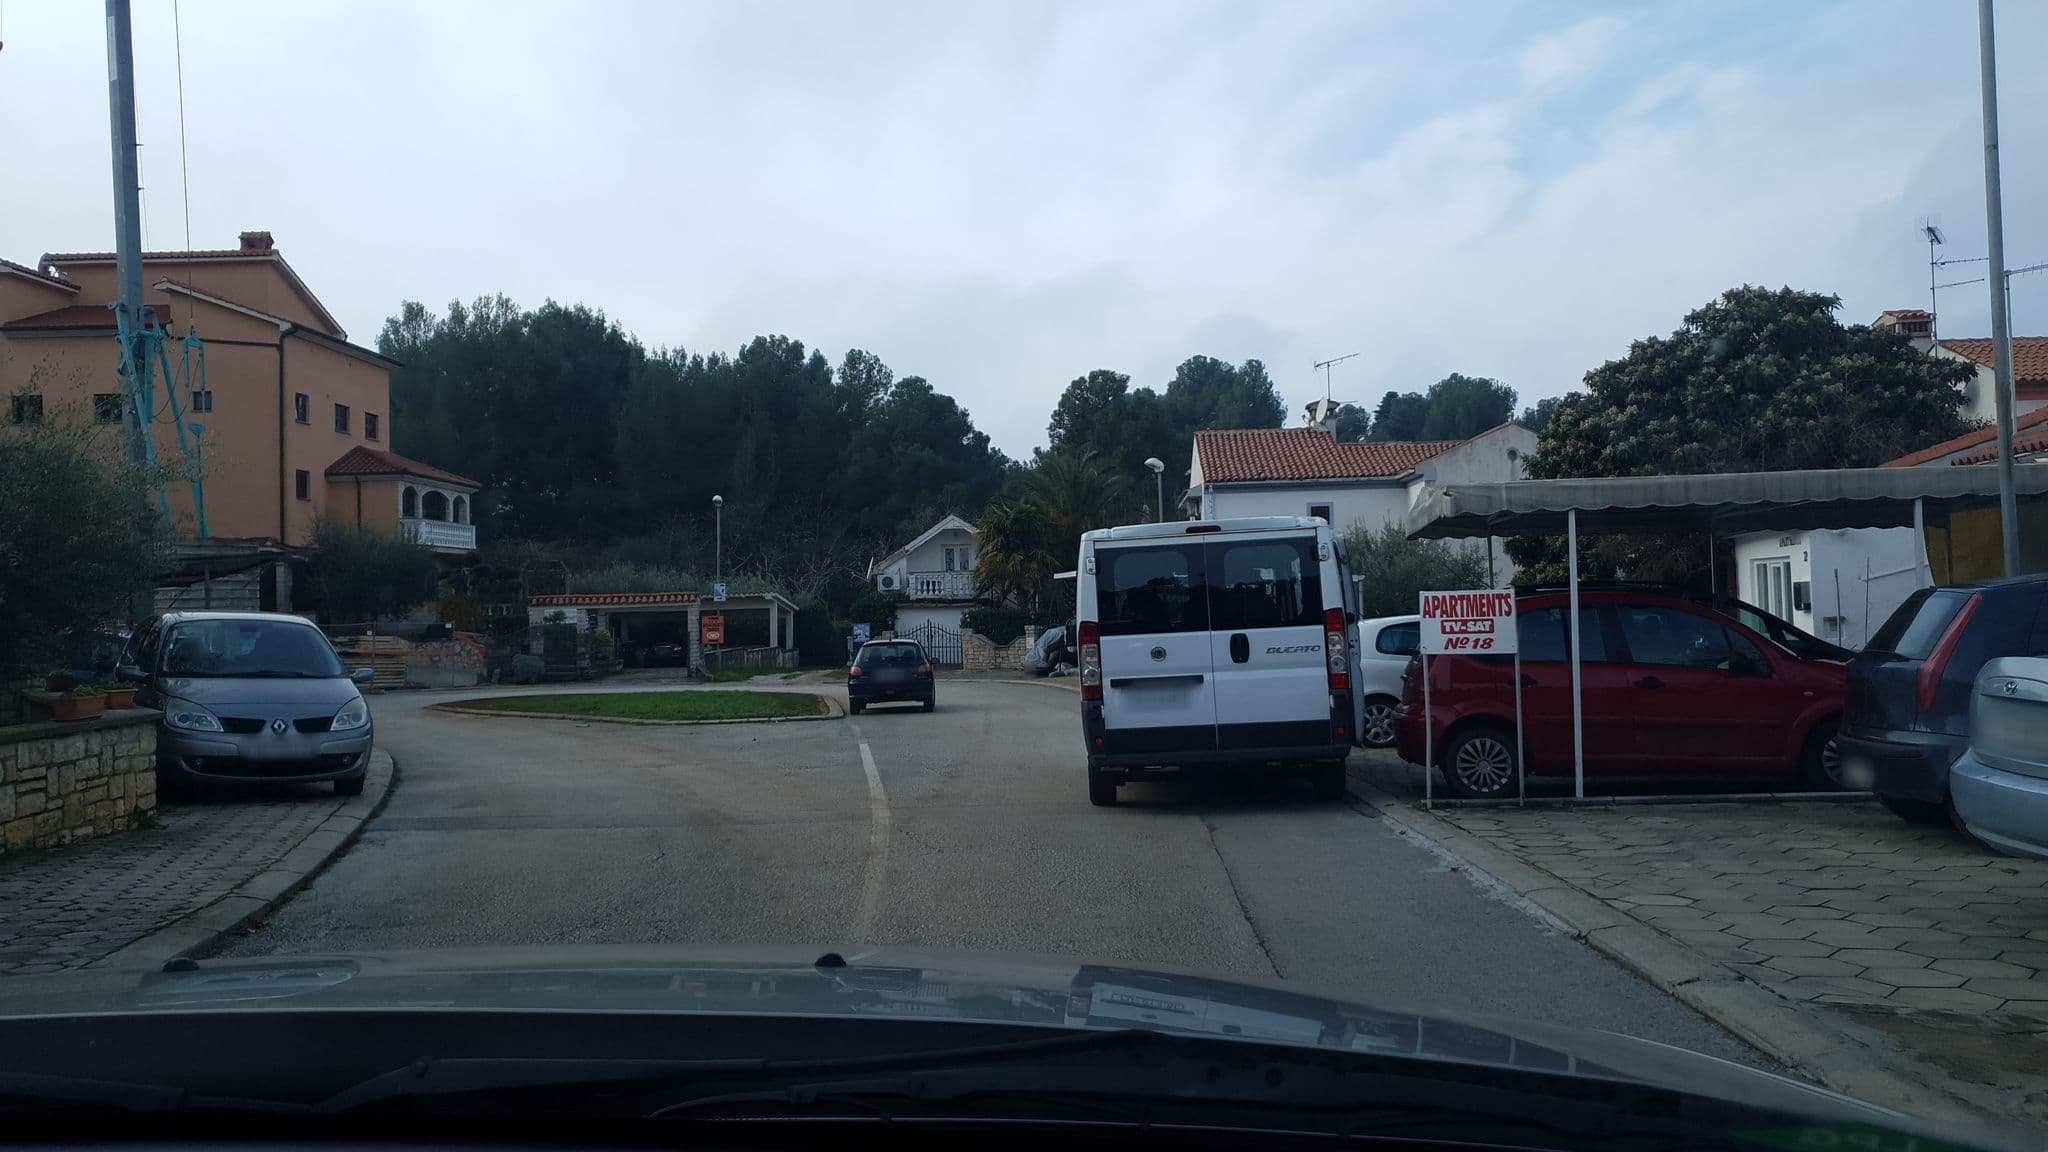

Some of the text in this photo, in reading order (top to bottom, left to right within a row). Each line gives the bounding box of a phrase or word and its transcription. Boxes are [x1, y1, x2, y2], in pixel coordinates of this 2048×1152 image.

[1422, 592, 1513, 618] APARTMENTS
[1442, 621, 1491, 632] TV-SAT
[1472, 637, 1494, 650] 18
[1266, 645, 1320, 655] DUCATO
